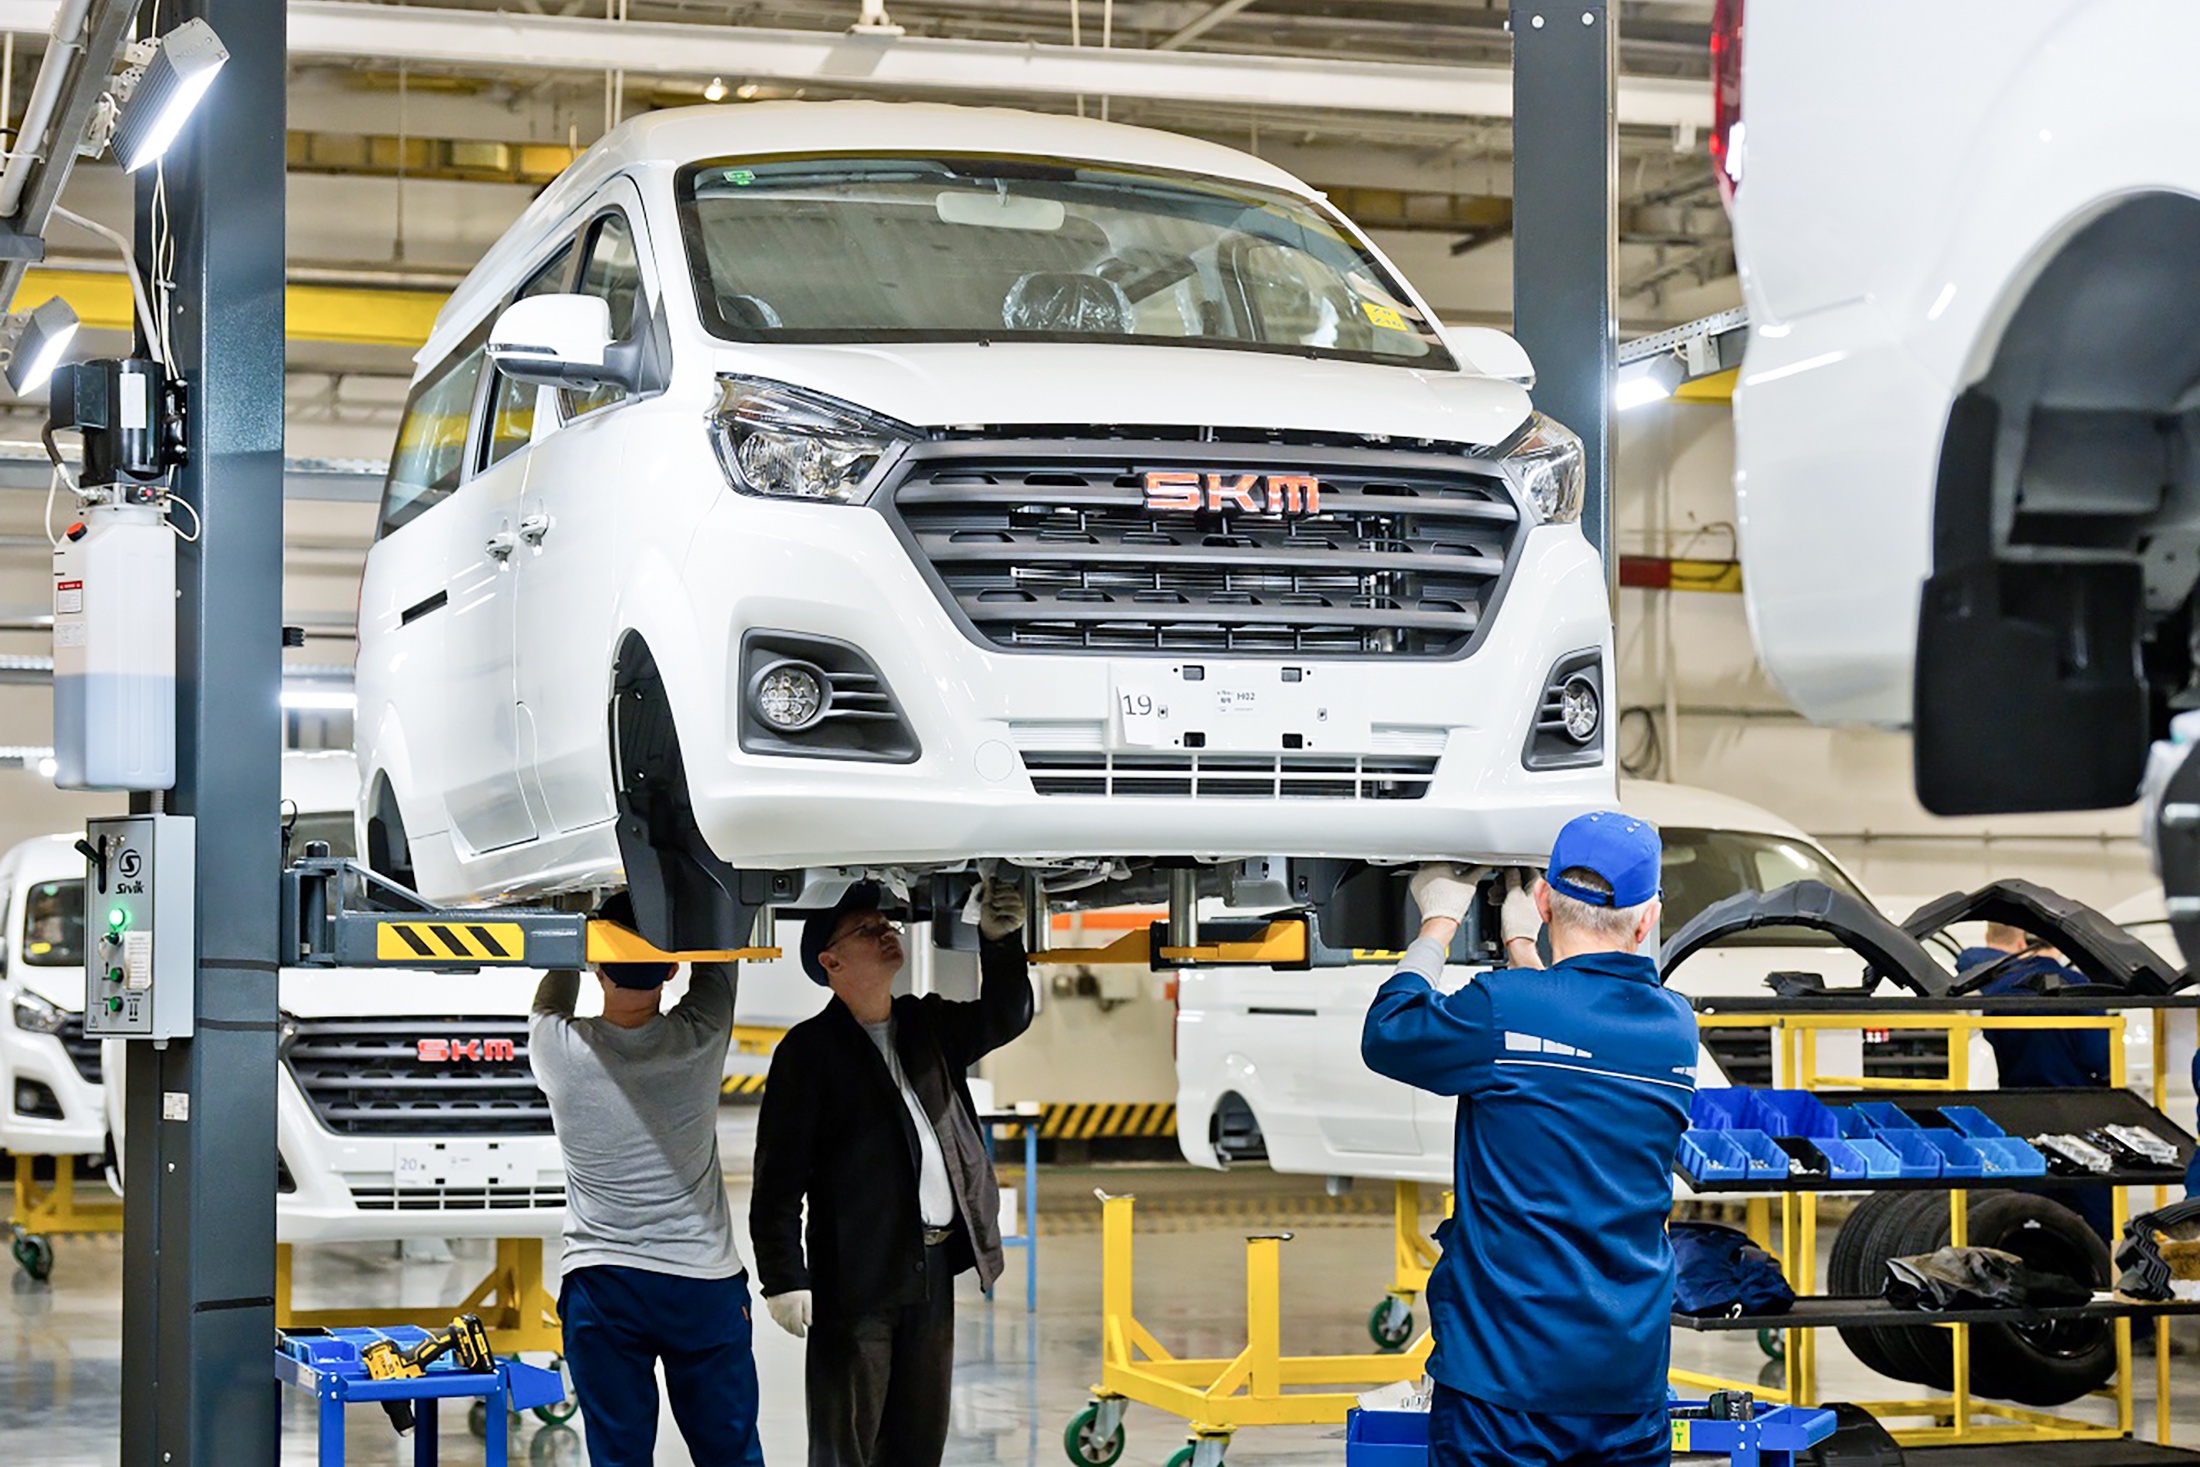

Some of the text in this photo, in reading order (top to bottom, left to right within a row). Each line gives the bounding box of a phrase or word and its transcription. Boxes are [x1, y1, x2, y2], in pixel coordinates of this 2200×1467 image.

[1144, 472, 1321, 514] SKM
[1123, 694, 1152, 716] 19
[116, 881, 144, 894] Sivik
[417, 1039, 514, 1062] SKM
[400, 1158, 417, 1171] 20
